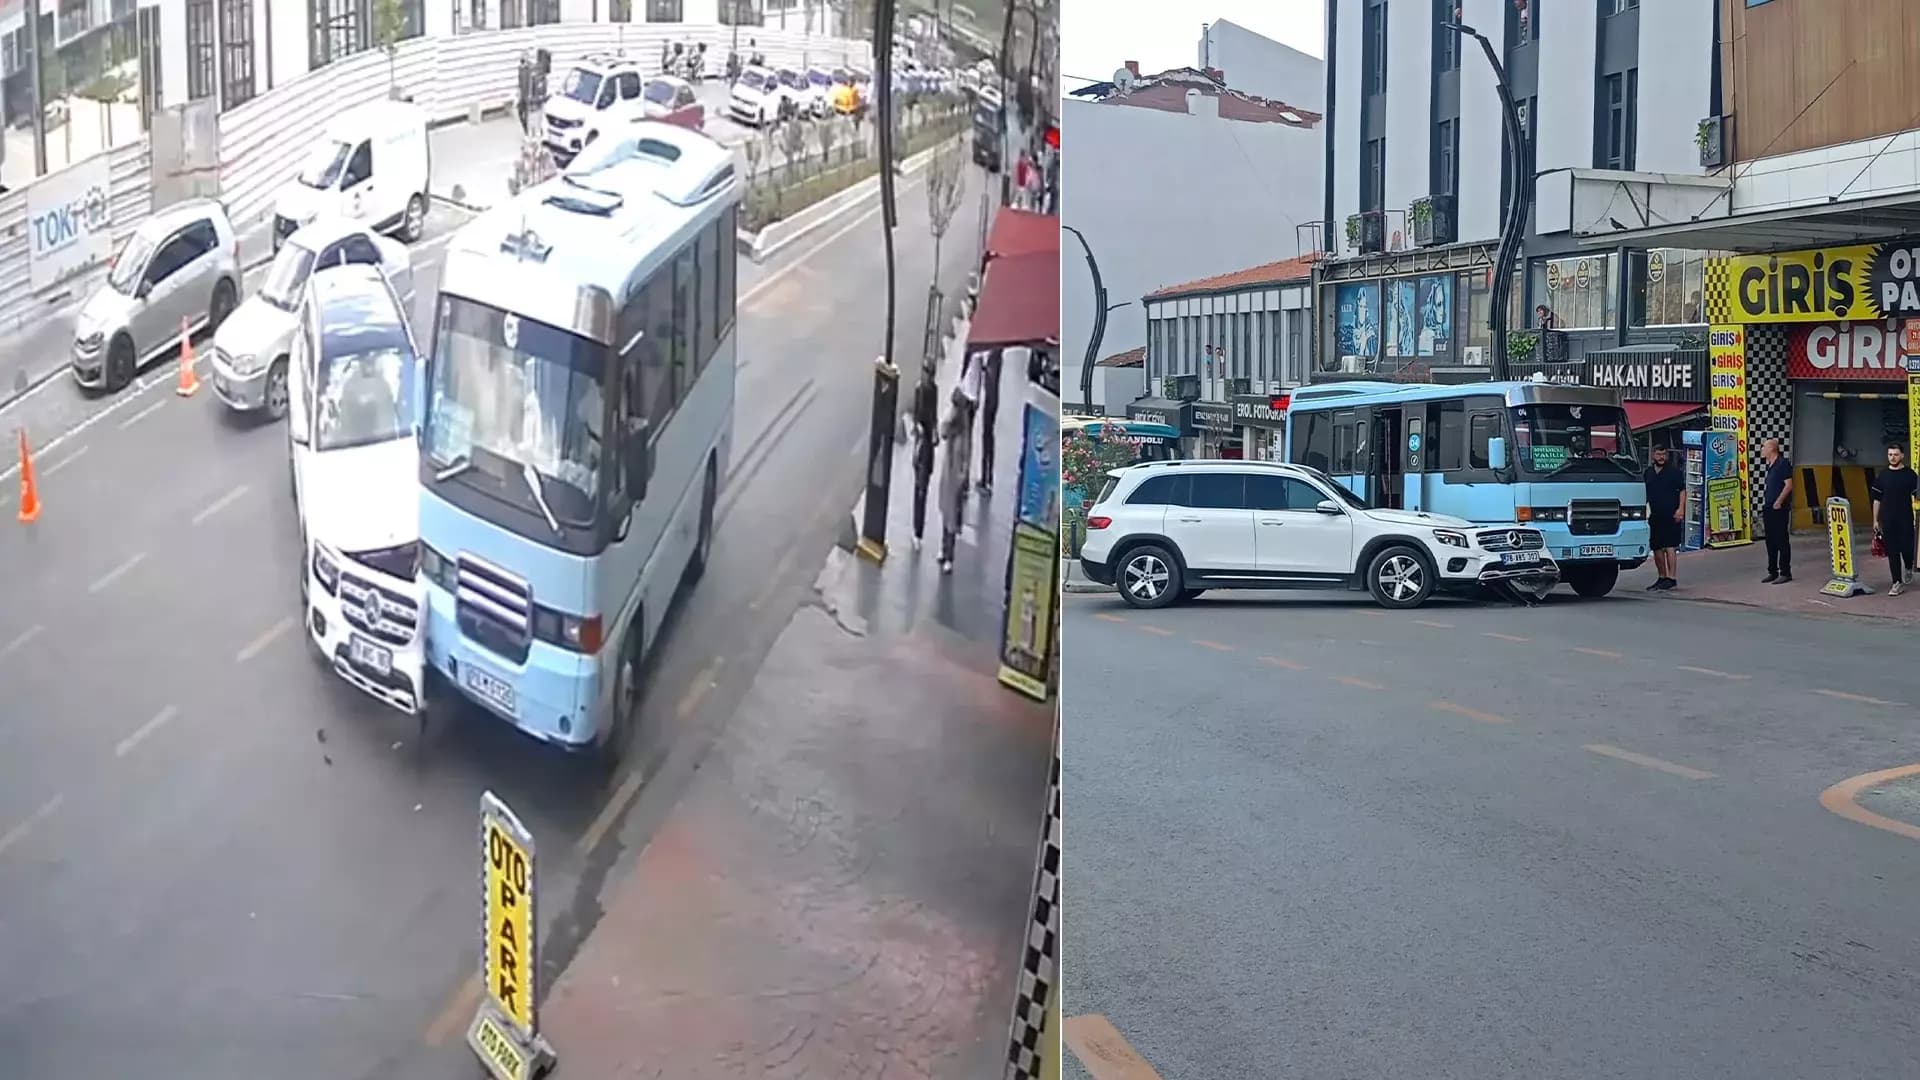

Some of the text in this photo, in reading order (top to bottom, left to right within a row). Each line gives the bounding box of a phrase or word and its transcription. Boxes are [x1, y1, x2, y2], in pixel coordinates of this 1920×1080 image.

[1739, 252, 1854, 317] GİRİŞ
[1711, 330, 1735, 346] GİRİŞ
[1717, 352, 1743, 369] GİRİŞ
[1593, 358, 1692, 388] HAKAN BÜFE
[1712, 372, 1736, 389] GİRİŞ
[1718, 394, 1745, 412] GİRİŞ
[1713, 414, 1738, 431] GİRİŞ
[1831, 507, 1847, 524] OTO
[1837, 525, 1848, 574] PARK
[489, 827, 526, 896] OTO
[500, 879, 518, 1015] PARK
